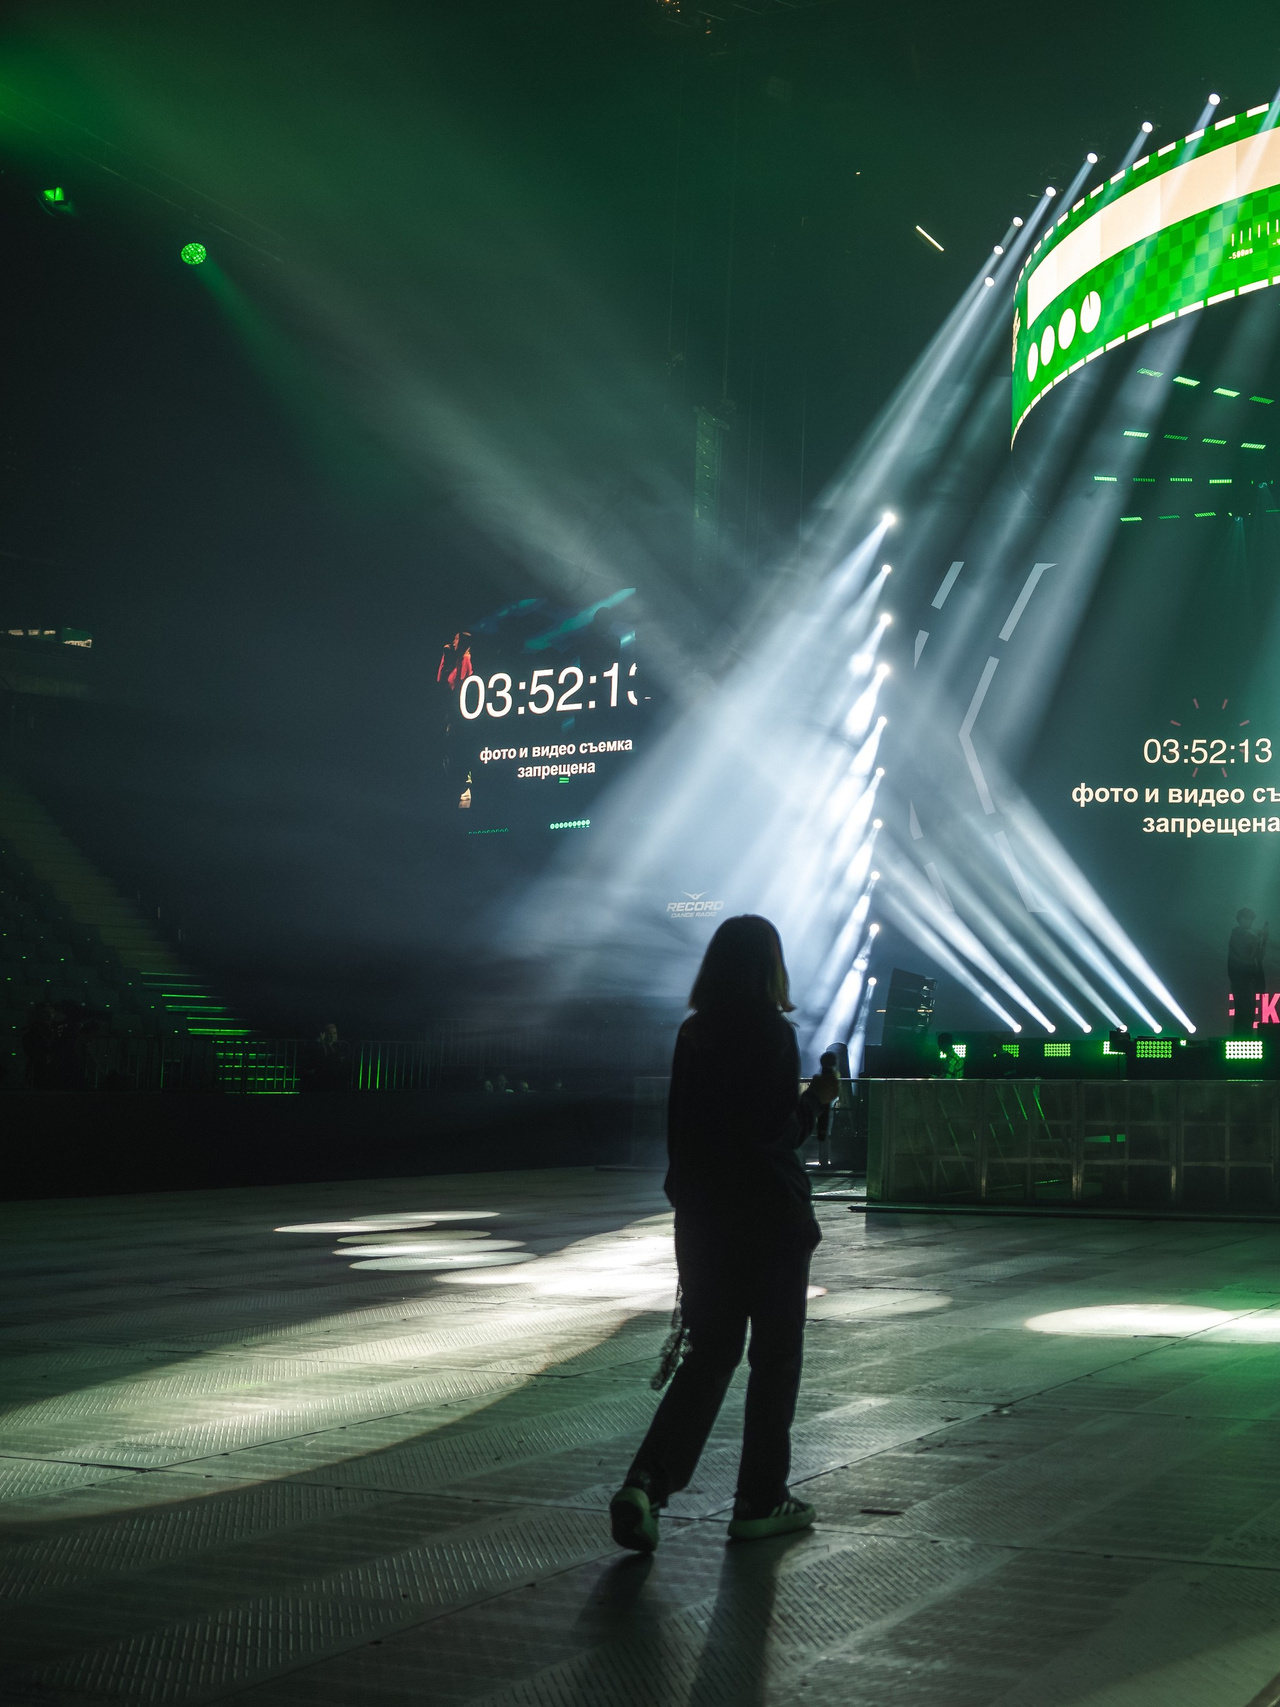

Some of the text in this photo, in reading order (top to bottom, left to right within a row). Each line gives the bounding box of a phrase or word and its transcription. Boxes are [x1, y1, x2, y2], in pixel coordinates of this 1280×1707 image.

[480, 739, 632, 764] фото и видео съемка
[1143, 738, 1272, 764] 03:52:13
[517, 762, 595, 779] запрещена
[1071, 782, 1138, 807] фото
[1145, 787, 1159, 803] и
[1168, 788, 1245, 807] видео
[1142, 816, 1280, 838] запрещена
[666, 900, 724, 912] RECORD
[671, 911, 695, 919] DANCE
